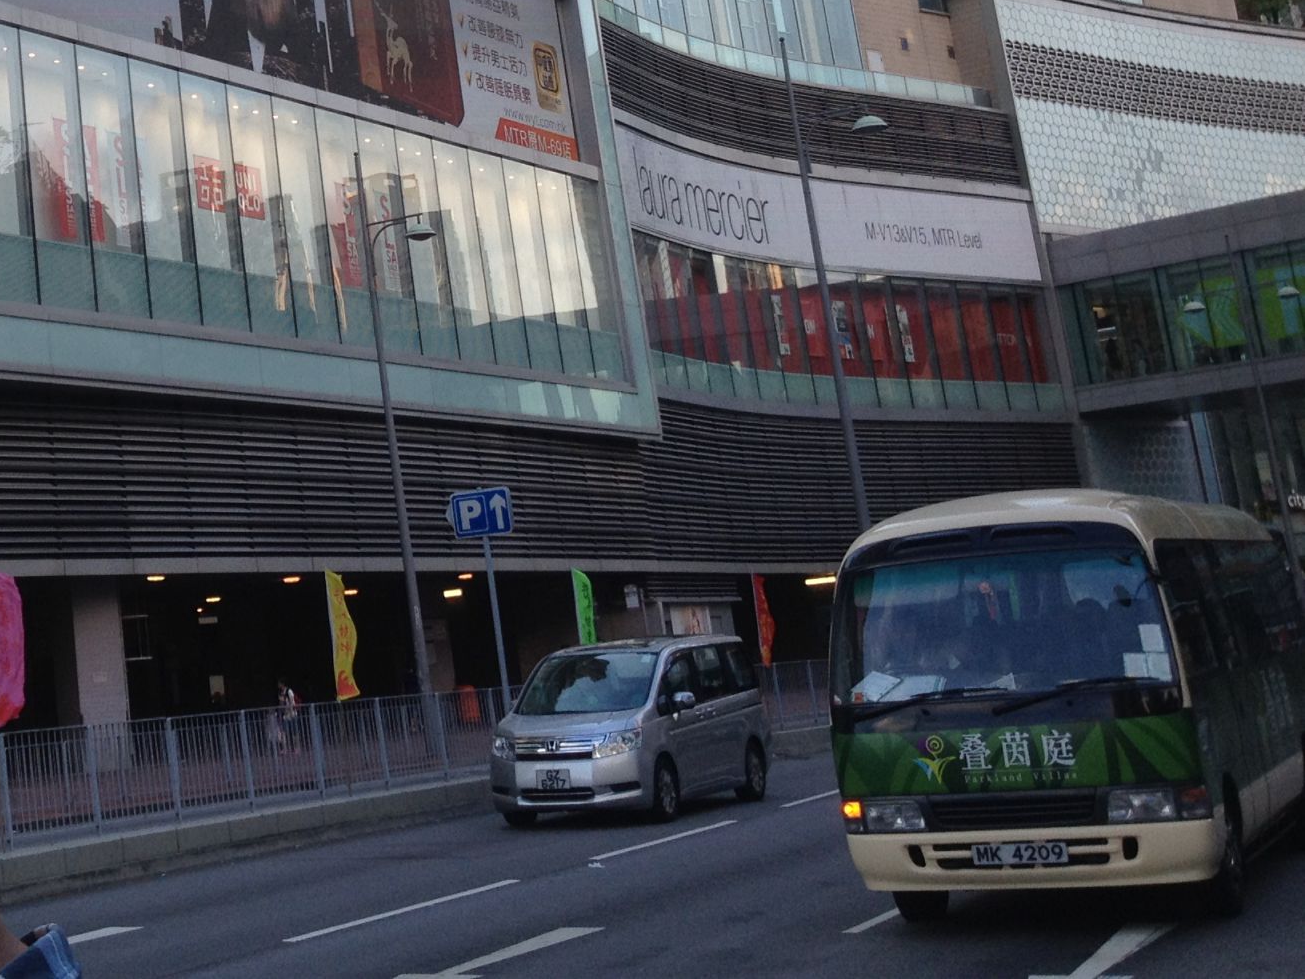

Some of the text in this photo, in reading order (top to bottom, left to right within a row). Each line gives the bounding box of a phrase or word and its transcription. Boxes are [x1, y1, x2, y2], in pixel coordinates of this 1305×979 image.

[684, 180, 770, 244] mercier
[933, 230, 955, 248] MTR
[957, 231, 983, 250] Level
[460, 499, 481, 530] P
[959, 729, 1076, 770] 叠茵庭
[976, 844, 1063, 862] MK 4209
